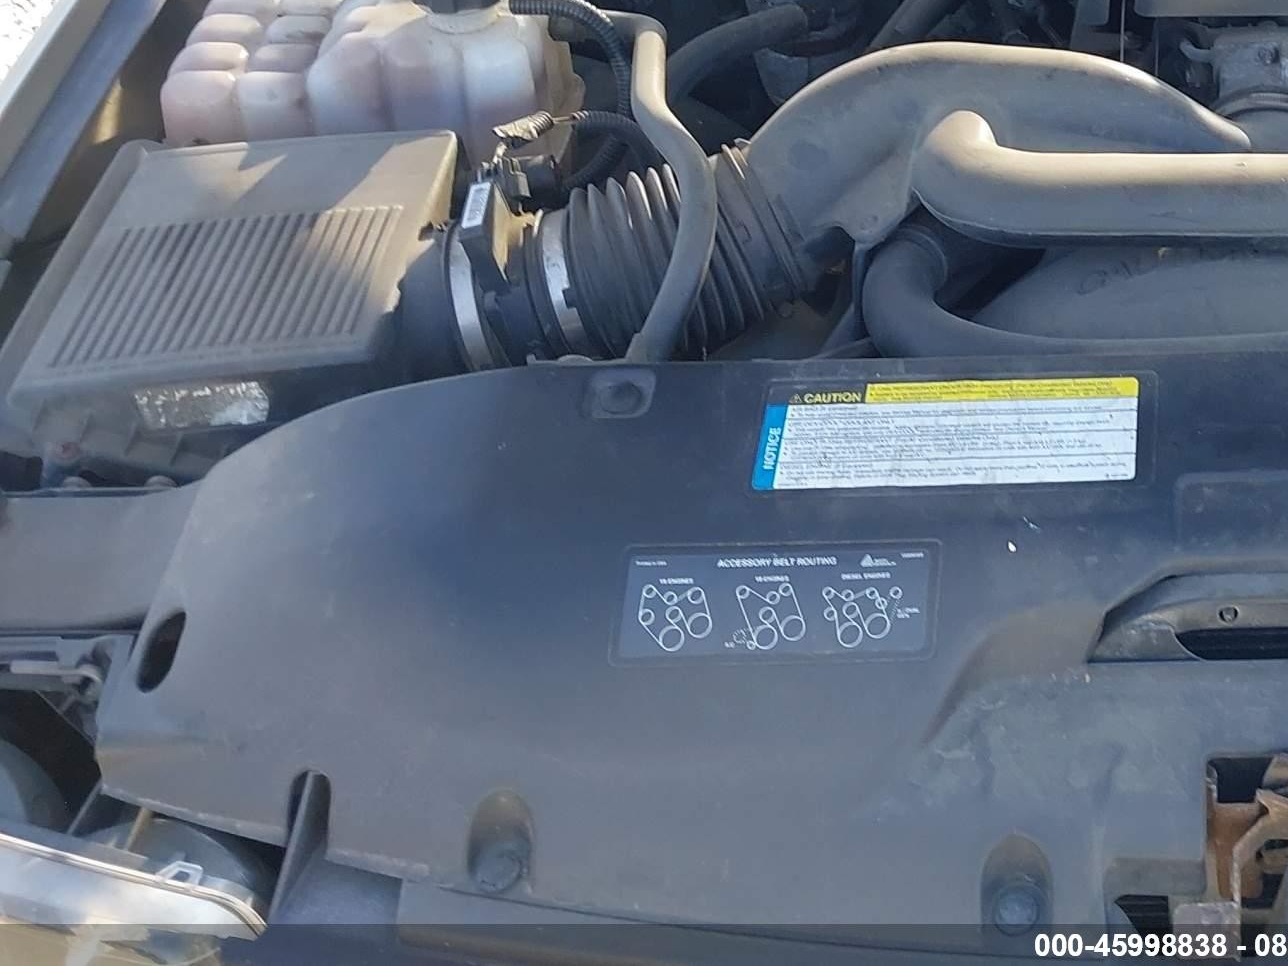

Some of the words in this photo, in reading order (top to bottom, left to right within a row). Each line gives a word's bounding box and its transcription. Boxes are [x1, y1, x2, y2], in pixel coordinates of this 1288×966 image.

[803, 392, 862, 404] CAUTION
[763, 427, 782, 469] NOTICE
[716, 557, 771, 568] ACCESSORY
[772, 556, 796, 567] BELT
[797, 555, 838, 567] ROUTING
